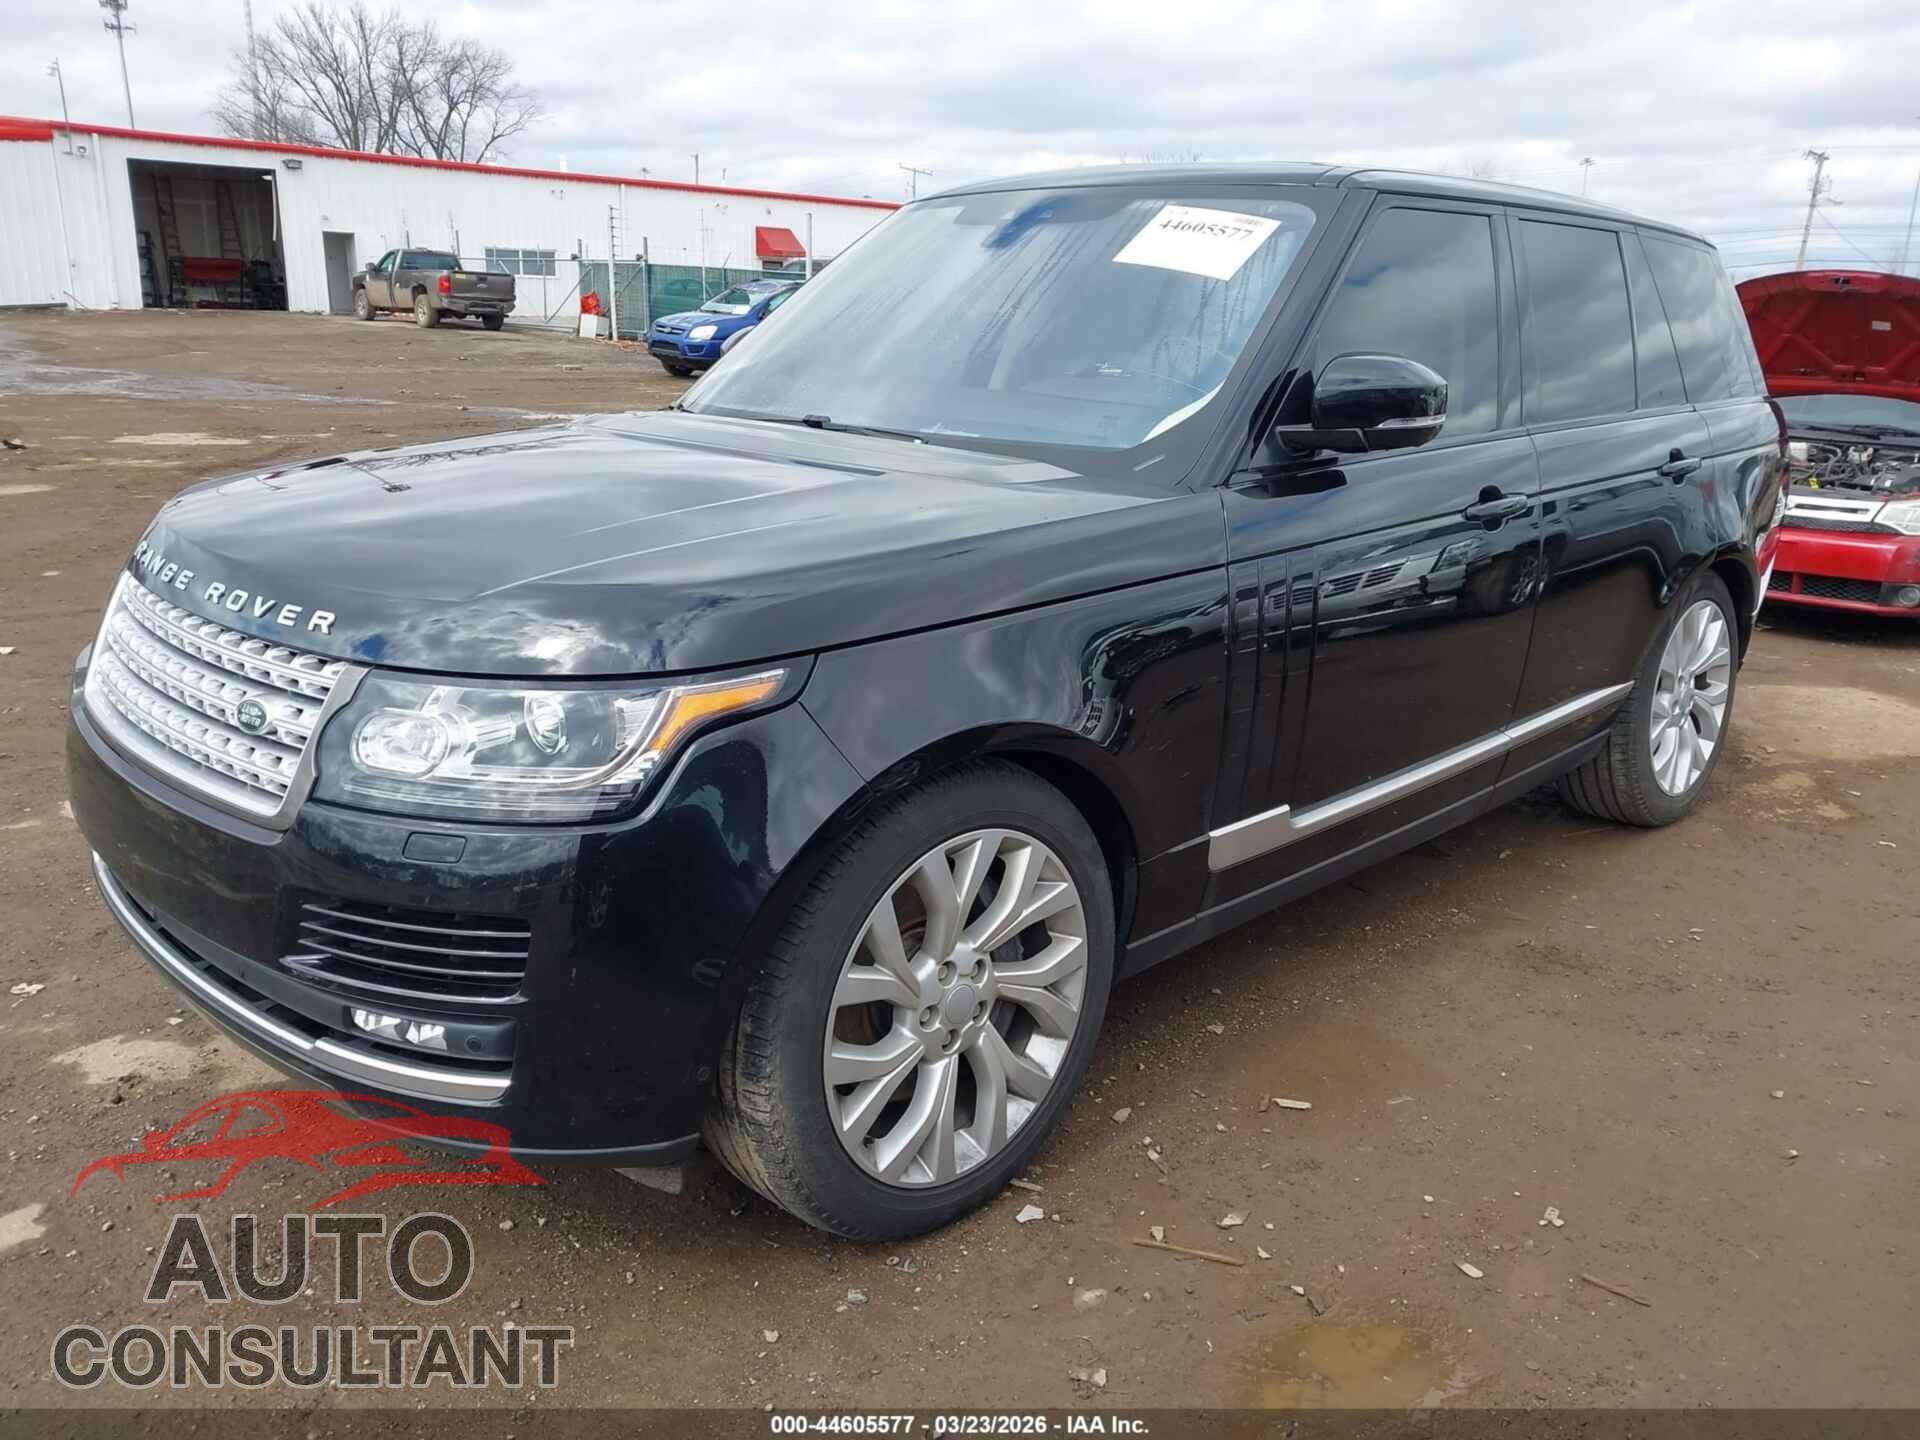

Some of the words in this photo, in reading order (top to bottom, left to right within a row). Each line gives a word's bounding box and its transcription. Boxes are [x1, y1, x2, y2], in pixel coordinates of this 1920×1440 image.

[1159, 218, 1255, 240] 44605577
[134, 541, 195, 590] RANGE
[204, 582, 336, 635] ROVER
